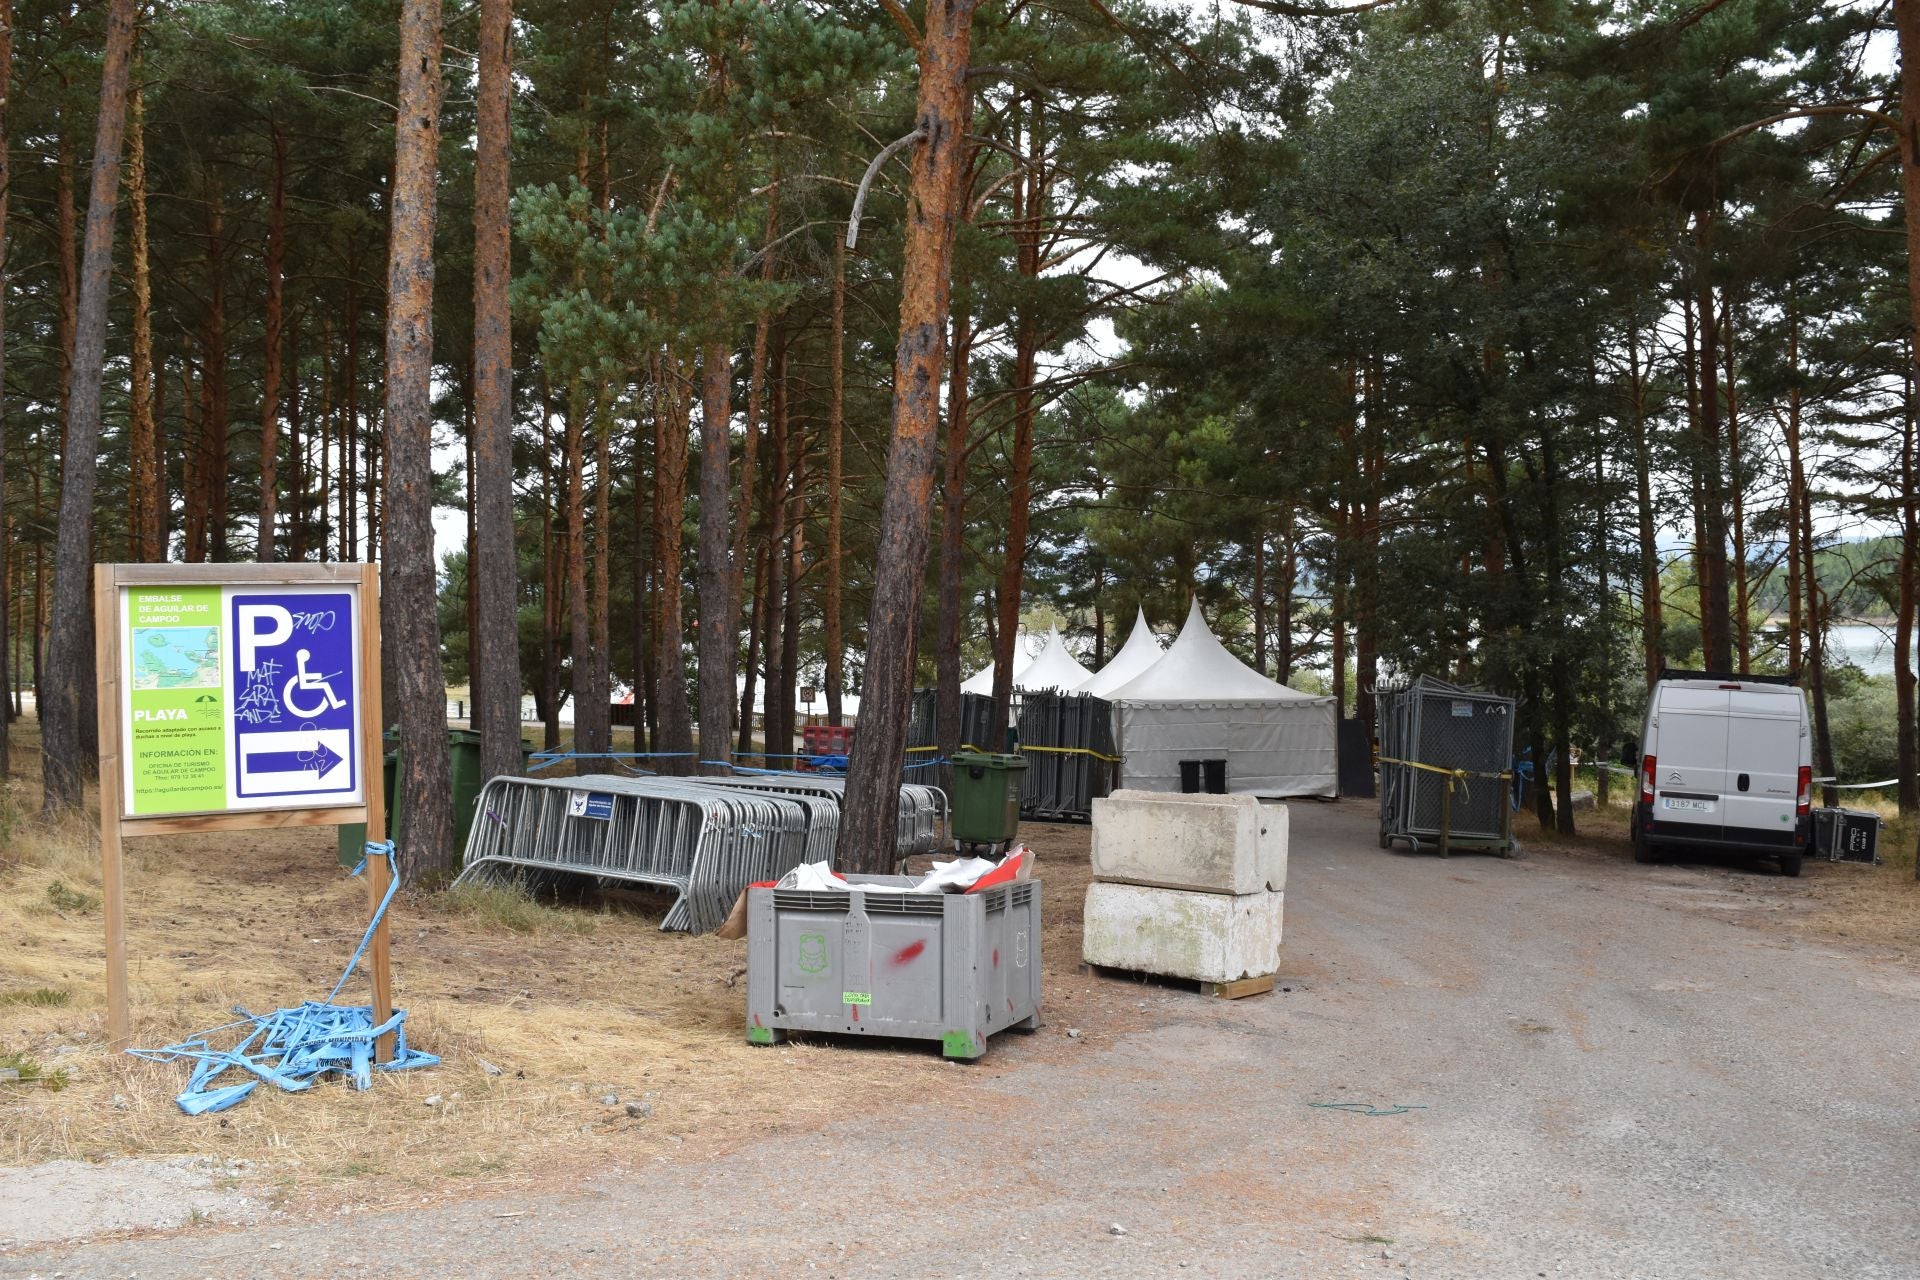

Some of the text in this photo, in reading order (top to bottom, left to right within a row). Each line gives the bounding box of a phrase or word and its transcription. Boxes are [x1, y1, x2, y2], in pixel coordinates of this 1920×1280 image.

[139, 595, 183, 603] EMBALSE
[139, 604, 209, 613] DE AGUILAR DE
[139, 615, 180, 623] CAMPOO
[238, 604, 294, 673] P
[134, 708, 188, 721] PLAYA
[139, 748, 218, 759] INFORMACIÓN EN:
[1671, 800, 1708, 810] 3187 MCL
